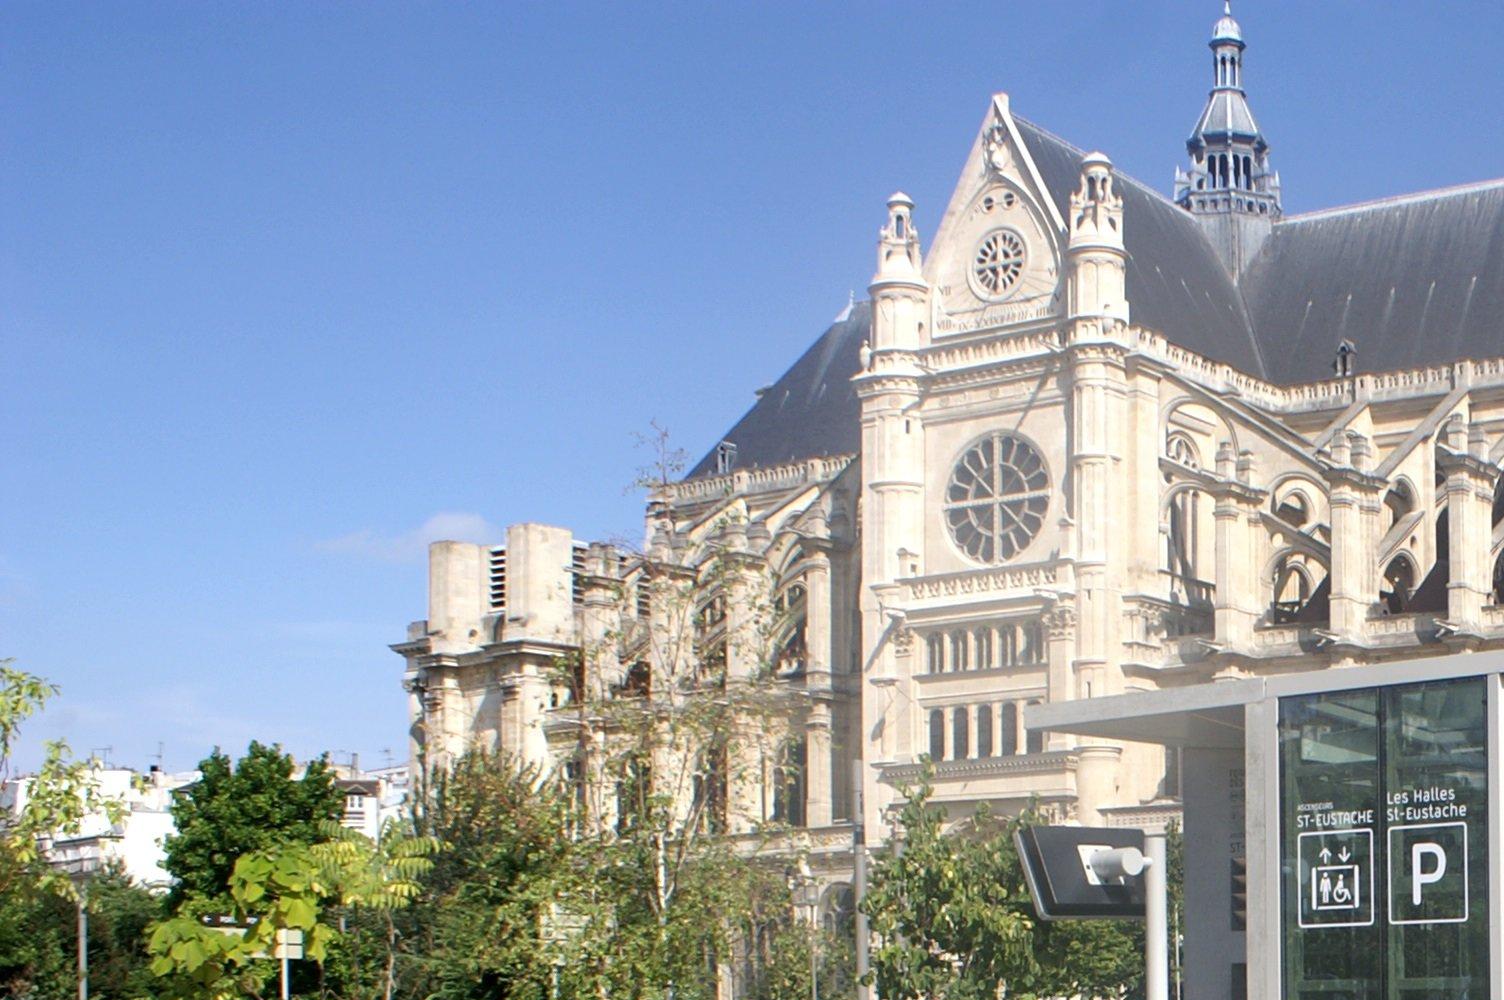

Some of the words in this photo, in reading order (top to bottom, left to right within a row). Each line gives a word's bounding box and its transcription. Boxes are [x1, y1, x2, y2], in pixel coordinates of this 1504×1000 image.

[1387, 791, 1409, 805] Les
[1413, 787, 1456, 803] Halles
[1297, 809, 1374, 828] ST-EUSTACHE
[1387, 803, 1467, 822] St-Eustache
[1412, 842, 1447, 906] P
